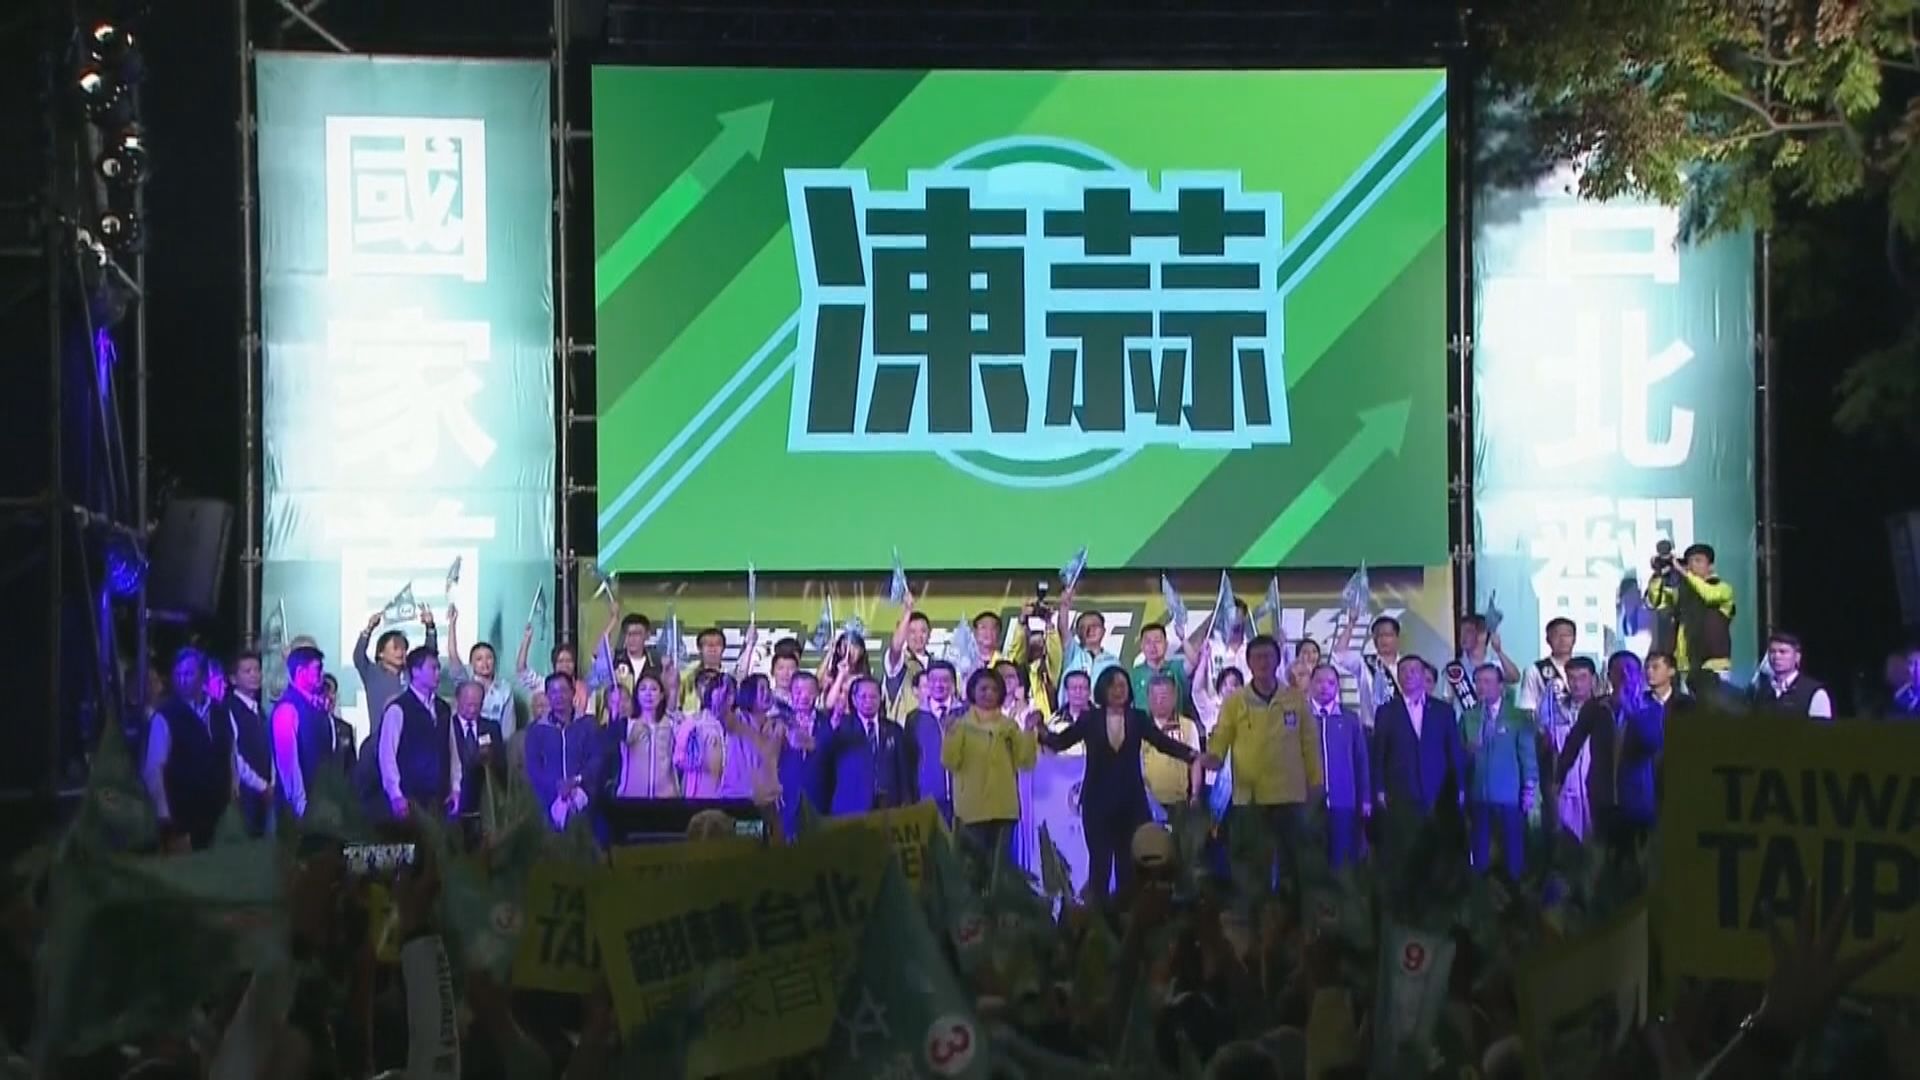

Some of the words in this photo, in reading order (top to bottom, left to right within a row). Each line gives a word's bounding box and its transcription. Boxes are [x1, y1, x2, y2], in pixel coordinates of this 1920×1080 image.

[803, 186, 1272, 434] 凍蒜
[1696, 832, 1920, 940] TAIP
[1403, 942, 1425, 971] 9
[930, 1023, 970, 1066] 3
